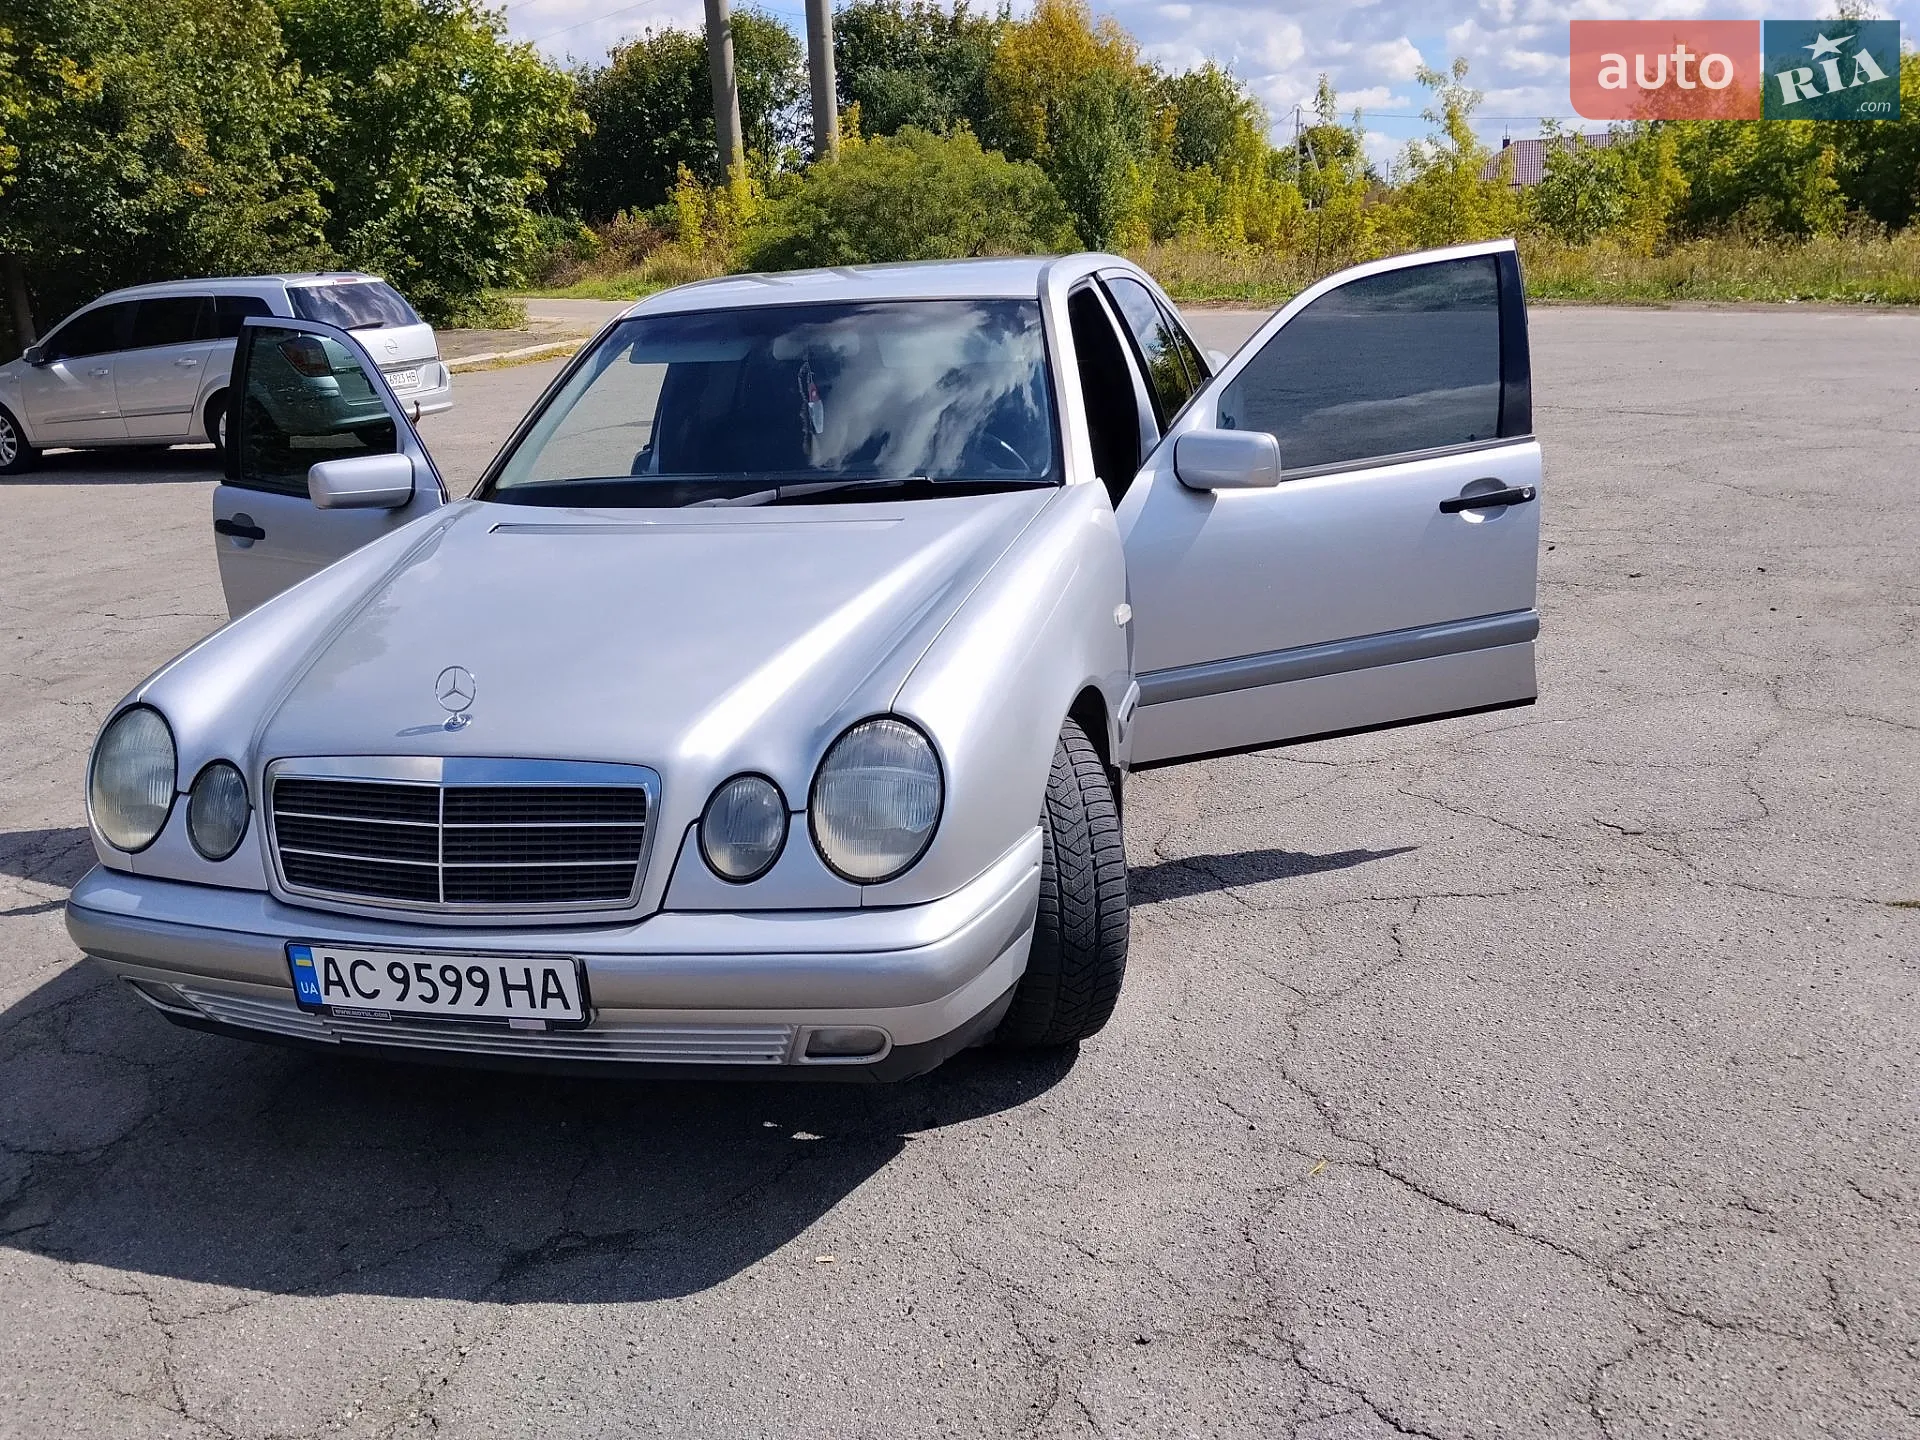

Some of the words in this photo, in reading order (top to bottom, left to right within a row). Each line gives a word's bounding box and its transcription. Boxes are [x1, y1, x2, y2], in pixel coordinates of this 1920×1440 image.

[301, 981, 319, 996] UA
[323, 956, 381, 1000] AC
[386, 961, 491, 1007] 9599
[498, 966, 572, 1011] HA
